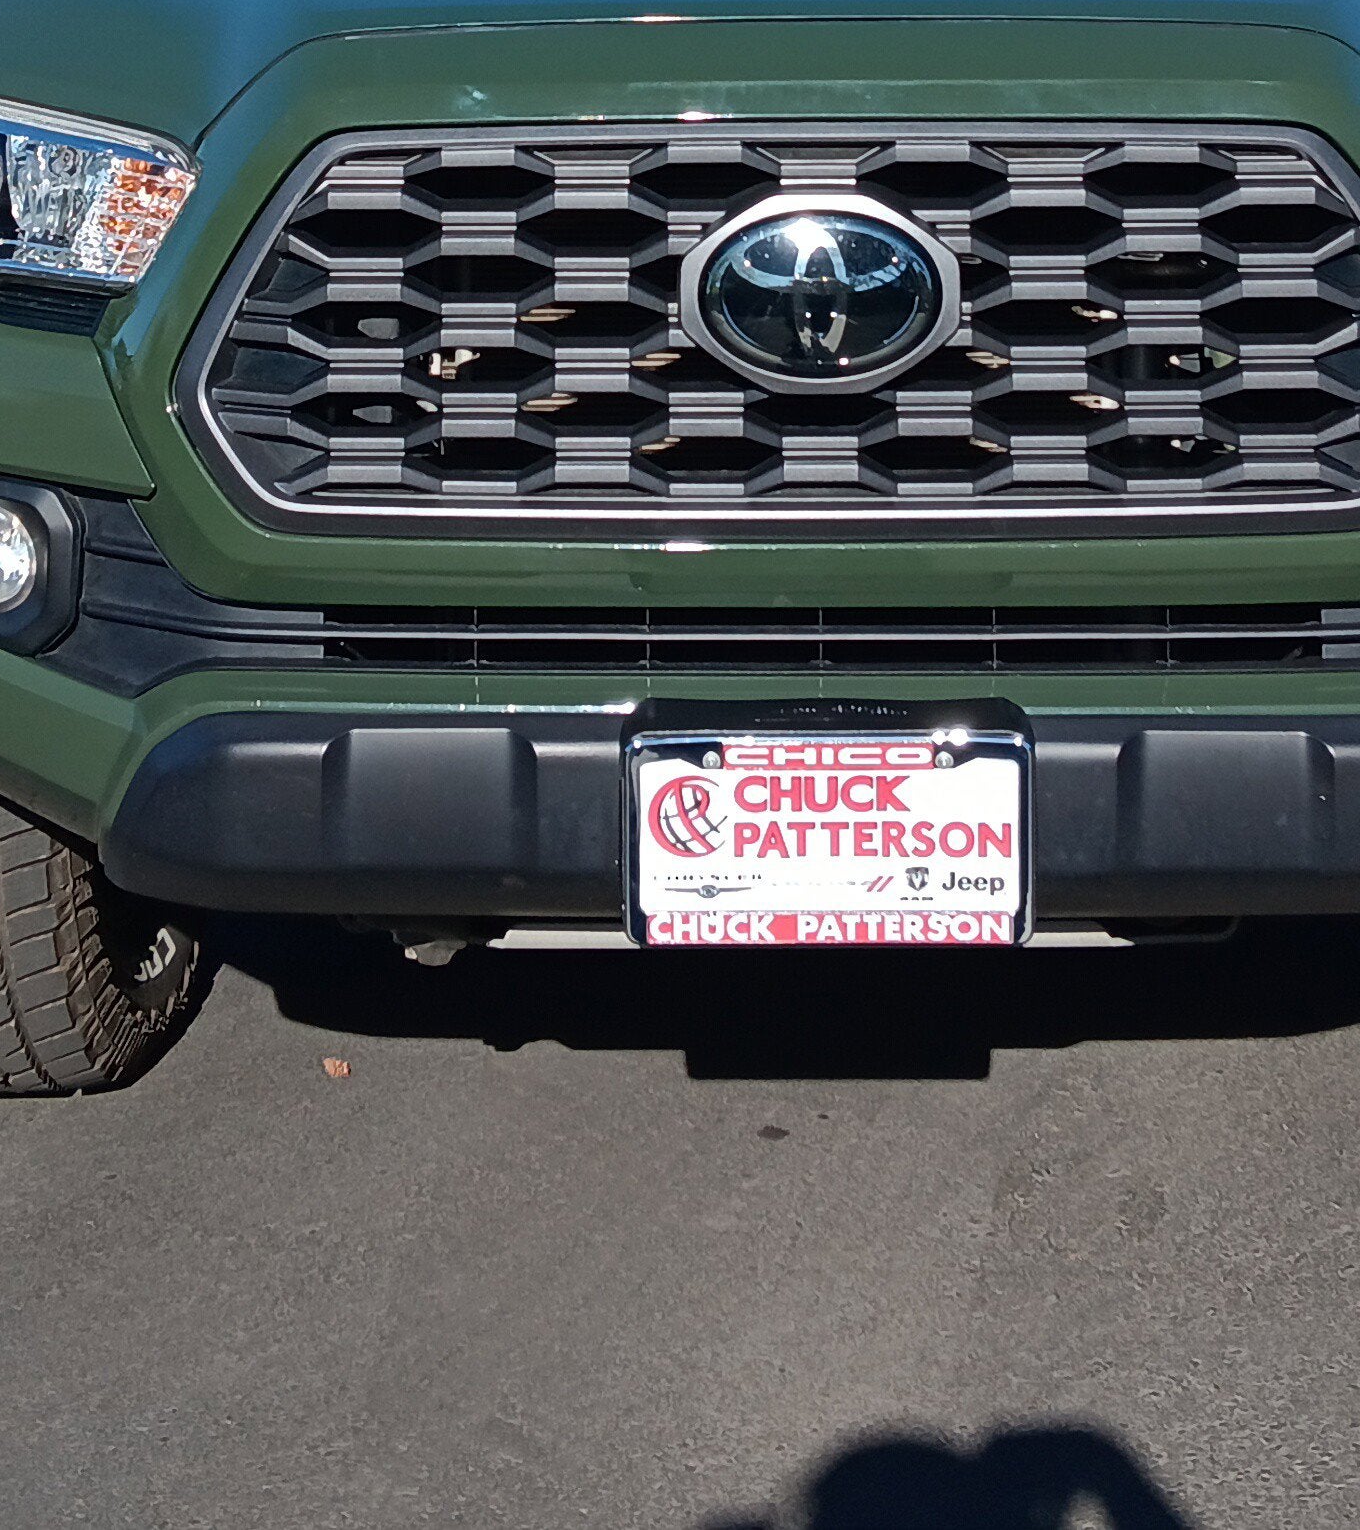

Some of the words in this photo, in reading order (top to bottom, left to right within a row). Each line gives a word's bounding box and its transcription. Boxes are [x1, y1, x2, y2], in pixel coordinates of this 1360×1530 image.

[724, 746, 933, 765] CHICO
[734, 774, 911, 812] CHUCK
[733, 820, 1012, 859] PATTERSON
[942, 871, 1005, 896] Jeep
[649, 911, 776, 942] CHUCK
[796, 912, 1011, 942] PATTERSON
